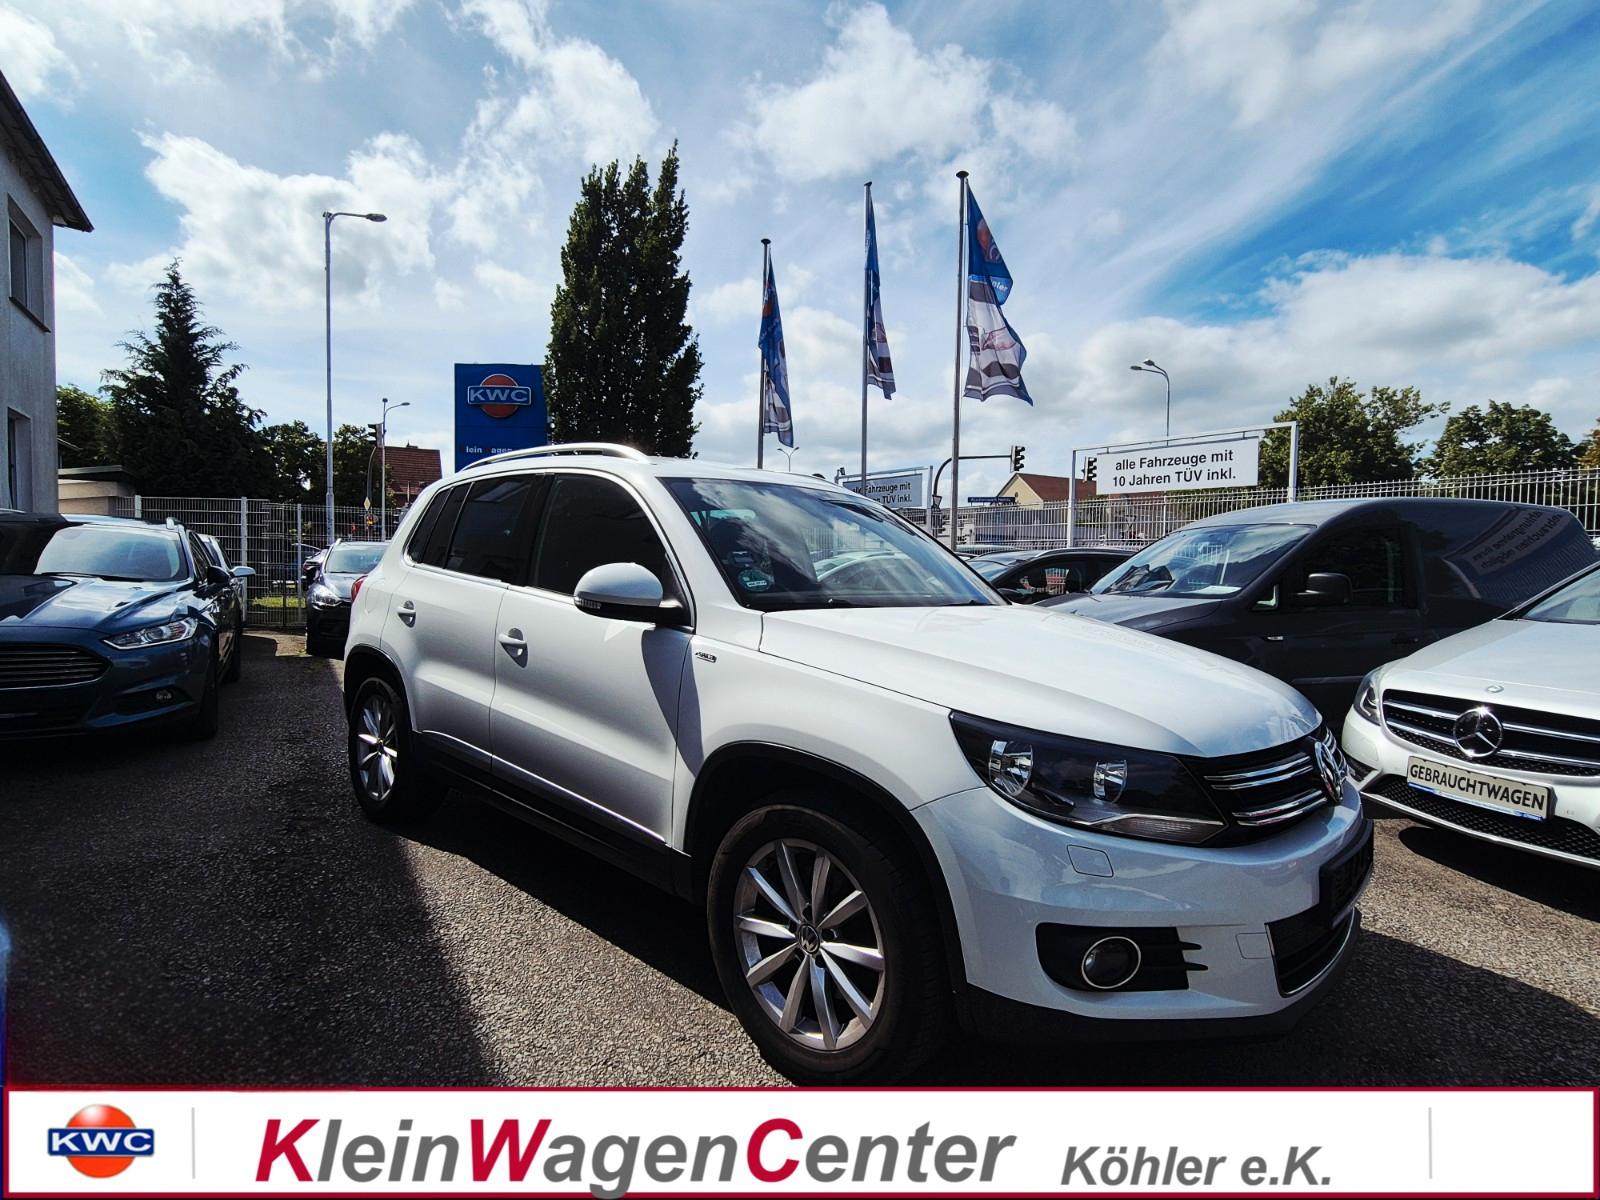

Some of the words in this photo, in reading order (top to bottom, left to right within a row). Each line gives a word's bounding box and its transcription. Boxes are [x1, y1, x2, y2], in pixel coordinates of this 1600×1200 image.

[470, 389, 528, 402] KWC
[1115, 458, 1136, 470] alle
[1140, 453, 1207, 469] Fahrzeuge
[1211, 449, 1234, 463] mit
[1113, 476, 1126, 487] 10
[1129, 473, 1171, 486] Jahren
[1175, 468, 1203, 483] TÜV
[1207, 467, 1237, 481] inkl.
[899, 481, 911, 491] mit
[883, 494, 897, 504] TÜV
[1410, 764, 1545, 810] GEBRAUCHTWAGEN
